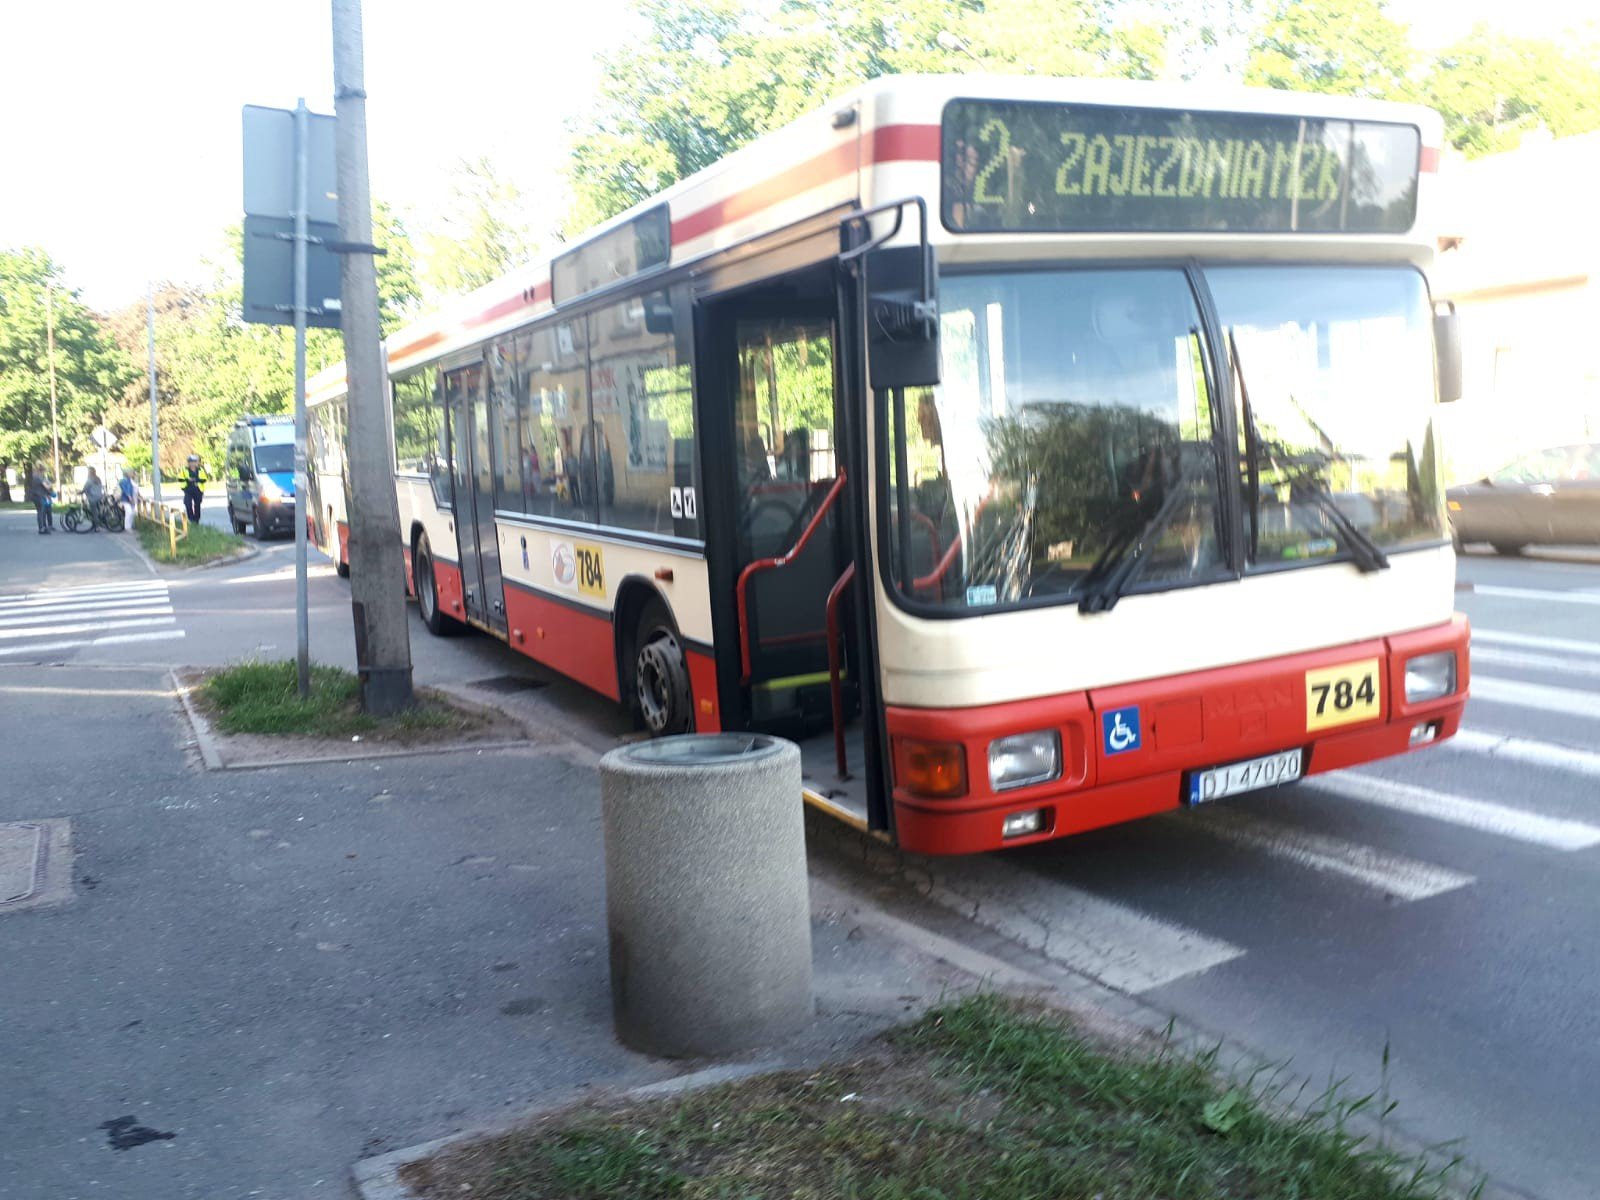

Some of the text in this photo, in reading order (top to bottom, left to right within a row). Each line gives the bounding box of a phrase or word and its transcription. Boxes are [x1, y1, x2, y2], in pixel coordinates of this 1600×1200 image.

[974, 118, 1010, 204] 2
[1054, 131, 1268, 199] ZAJEZDNIA
[576, 549, 603, 590] 784
[1311, 673, 1376, 716] 784
[1203, 751, 1299, 801] DJ 47020
